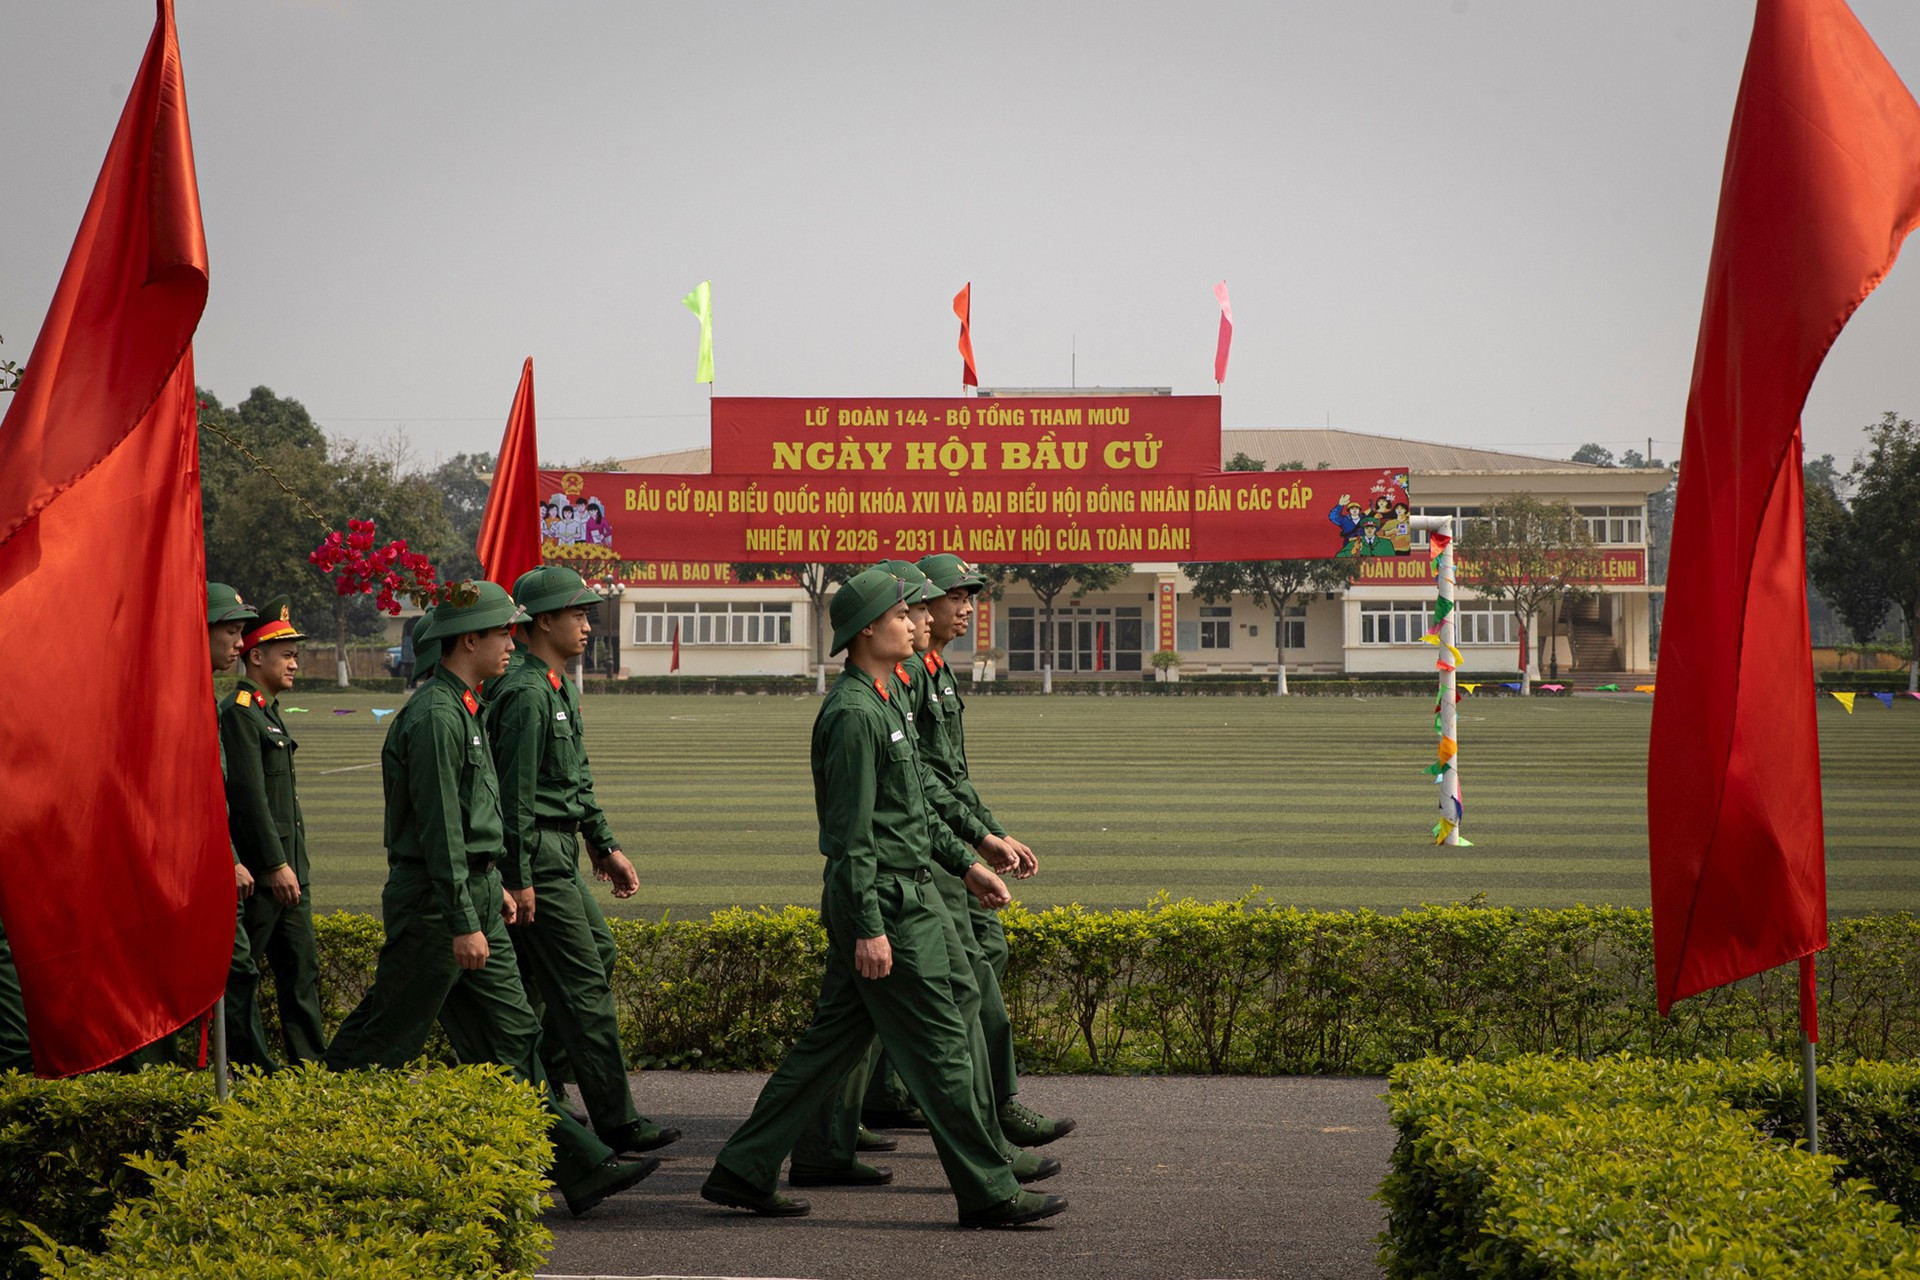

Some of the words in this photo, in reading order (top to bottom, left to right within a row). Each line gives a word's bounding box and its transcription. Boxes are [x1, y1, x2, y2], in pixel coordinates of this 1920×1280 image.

[805, 406, 830, 427] LỮ
[837, 405, 889, 427] ĐOÀN
[895, 409, 928, 427] 144
[946, 405, 971, 430] BỘ
[976, 402, 1025, 426] TỔNG
[1029, 408, 1082, 426] THAM
[1087, 406, 1130, 426] MƯU
[772, 435, 893, 471] NGÀY
[905, 435, 988, 477] HỘI
[1000, 431, 1089, 470] BẦU
[1103, 432, 1164, 470] CỬ
[625, 481, 661, 512] BẦU
[665, 482, 691, 513] CỬ
[693, 489, 723, 518] ĐẠI
[728, 481, 769, 513] BIỂU
[773, 483, 820, 516] QUỐC
[825, 486, 855, 519] HỘI
[859, 487, 907, 514] KHÓA
[911, 491, 940, 514] XVI
[945, 486, 968, 514] VÀ
[972, 491, 1002, 519] ĐẠI
[1007, 481, 1047, 514] BIỂU
[1052, 486, 1082, 518] HỘI
[1086, 483, 1135, 513] ĐỒNG
[1140, 485, 1190, 513] NHÂN
[1195, 484, 1232, 512] DÂN
[1237, 483, 1272, 512] CÁC
[1277, 479, 1313, 510] CẤP
[746, 524, 803, 556] NHIỆM
[808, 524, 831, 552] KỲ
[835, 529, 879, 552] 2026
[895, 529, 936, 552] 2031
[943, 525, 965, 552] LÀ
[969, 524, 1017, 552] NGÀY
[1021, 524, 1051, 556] HỘI
[1056, 522, 1092, 551] CỦA
[1096, 525, 1143, 551] TOÀN
[1147, 523, 1191, 551] DÂN!
[1397, 559, 1426, 578] ĐƠN
[1602, 556, 1637, 582] LỆNH
